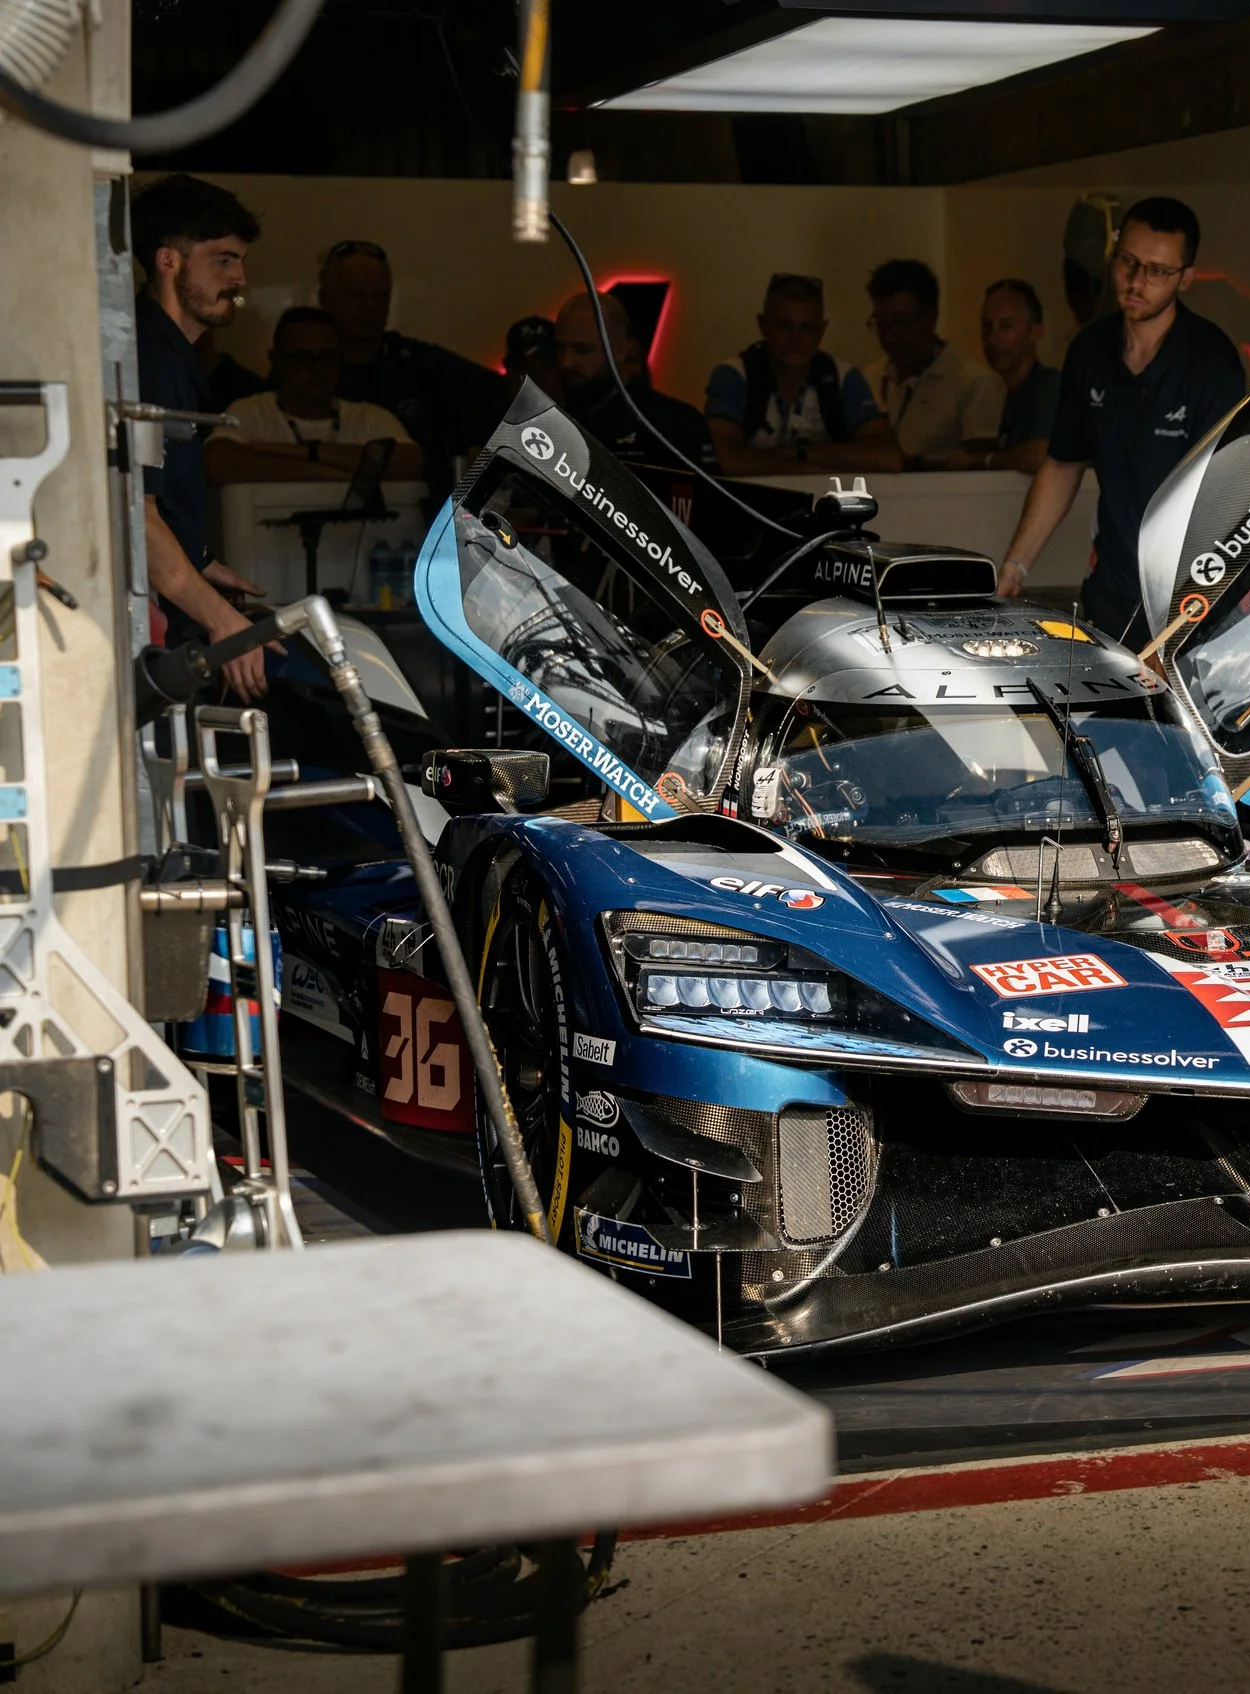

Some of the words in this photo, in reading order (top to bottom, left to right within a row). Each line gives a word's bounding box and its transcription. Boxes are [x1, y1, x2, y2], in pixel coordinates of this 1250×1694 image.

[553, 452, 704, 595] businessolver
[814, 560, 873, 587] ALPINE
[862, 672, 1160, 700] ALPINE
[523, 693, 660, 815] MOSER.WATCH
[709, 876, 785, 898] elf
[981, 956, 1095, 977] HYPER
[995, 967, 1115, 993] CAR
[548, 945, 570, 1104] MICHELIN
[1002, 1011, 1090, 1033] ixell
[382, 991, 461, 1112] 36
[576, 1035, 610, 1063] Sabelt
[1043, 1041, 1221, 1069] businessolver
[576, 1125, 621, 1158] BAHCO
[558, 1133, 567, 1179] PILOT
[551, 1179, 563, 1227] SPORT
[598, 1234, 685, 1263] MICHELIN
